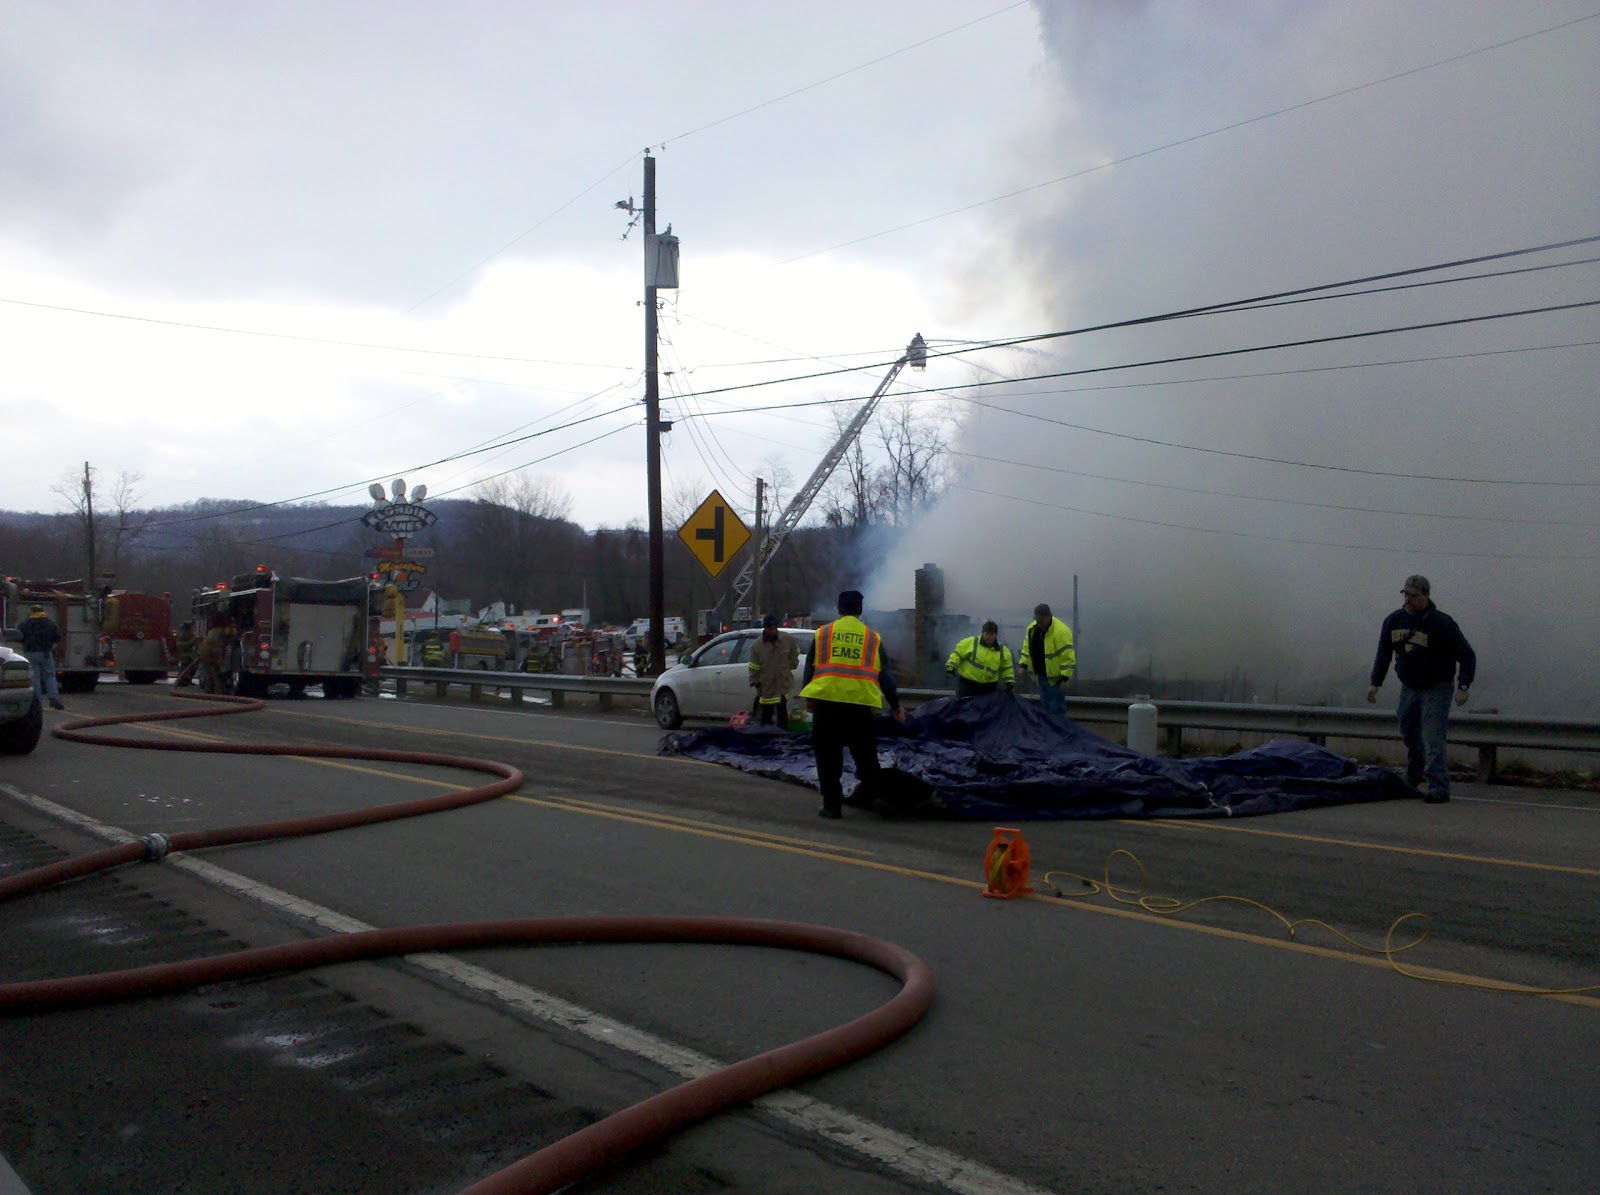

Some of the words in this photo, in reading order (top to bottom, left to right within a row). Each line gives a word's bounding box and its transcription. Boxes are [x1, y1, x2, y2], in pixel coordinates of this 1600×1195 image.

[382, 521, 423, 531] LANES
[378, 560, 425, 573] Miniature
[832, 632, 864, 645] FAYETTE
